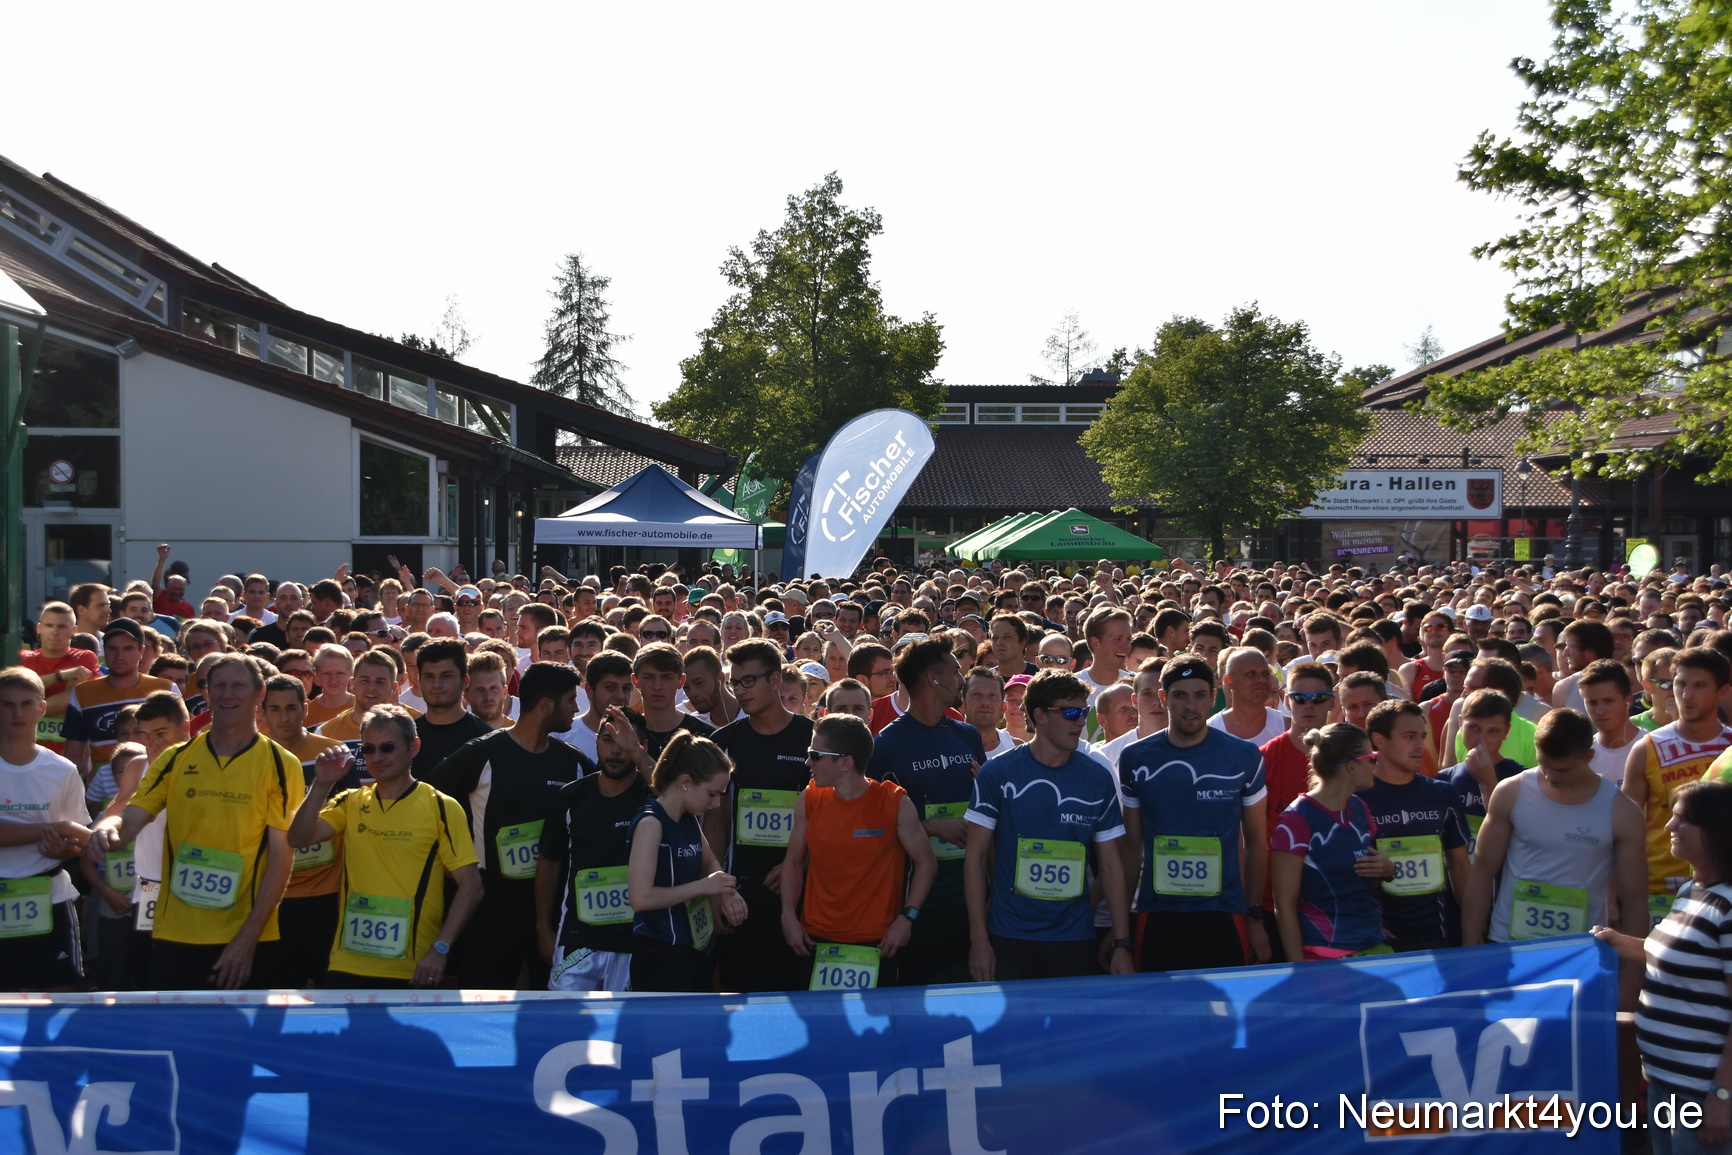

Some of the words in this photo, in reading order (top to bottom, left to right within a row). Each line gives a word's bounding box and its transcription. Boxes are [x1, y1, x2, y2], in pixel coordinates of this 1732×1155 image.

[838, 429, 907, 526] Fischer
[862, 447, 915, 525] AUTOMOBILE
[1389, 476, 1456, 490] Hallen
[1390, 505, 1430, 513] angenehmen
[1408, 498, 1425, 506] grüßt
[577, 529, 713, 540] www.fischer-automobile.de
[1331, 528, 1380, 539] Willkommen
[1353, 536, 1383, 545] meinem
[912, 759, 940, 771] EURO
[949, 754, 974, 766] POLES
[1661, 765, 1700, 784] MAX
[198, 790, 253, 801] SPANGLER
[1197, 789, 1224, 799] MCM
[744, 811, 793, 831] 1081
[1060, 813, 1083, 823] MCM
[1410, 810, 1439, 820] POLES
[113, 861, 136, 878] 15
[1029, 863, 1071, 884] 956
[1167, 859, 1208, 880] 958
[179, 868, 233, 895] 1359
[692, 907, 708, 934] 368
[1525, 907, 1571, 931] 353
[350, 917, 400, 942] 1361
[819, 966, 871, 990] 1030
[533, 1034, 1008, 1155] Start
